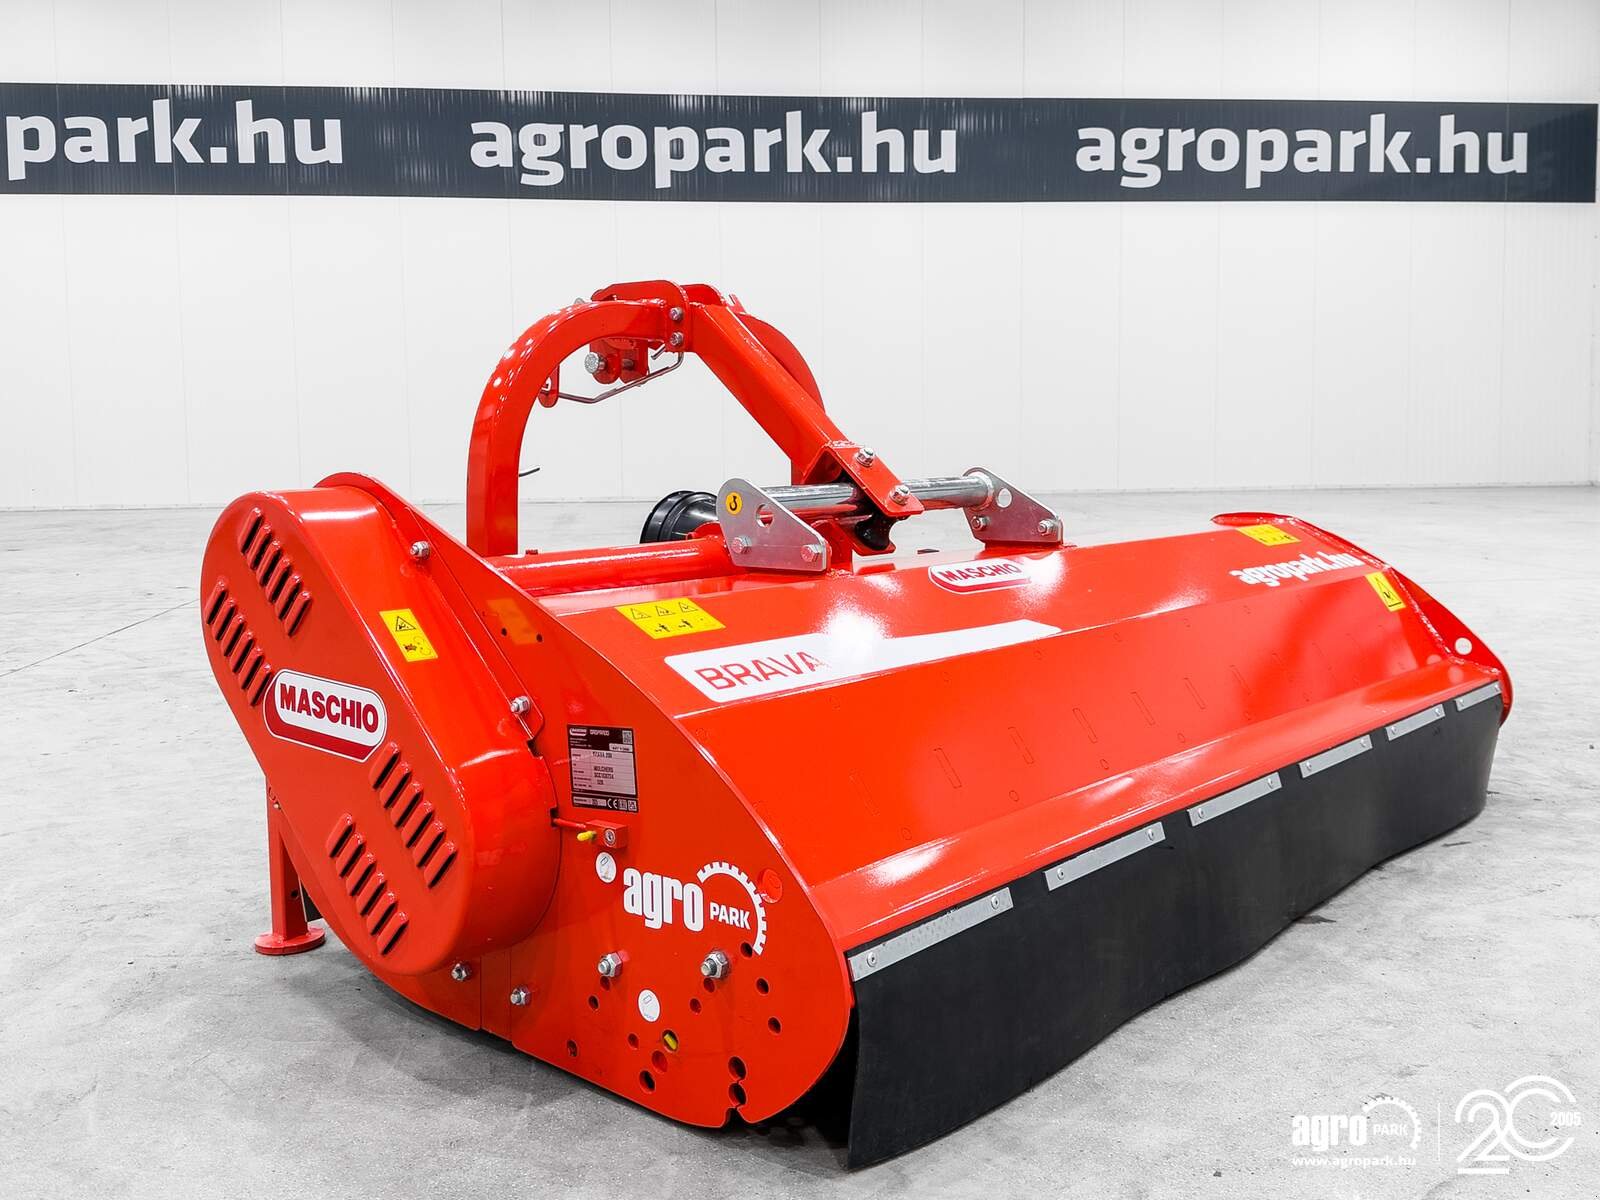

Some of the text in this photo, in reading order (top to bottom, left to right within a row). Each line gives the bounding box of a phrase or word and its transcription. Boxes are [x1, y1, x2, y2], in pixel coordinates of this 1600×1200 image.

[5, 98, 343, 181] park.hu
[470, 109, 957, 189] agropark.hu
[1075, 113, 1529, 190] agropark.hu
[938, 563, 1023, 582] MASCHIO
[1229, 551, 1366, 587] agropark.hu
[280, 682, 379, 734] MASCHIO
[623, 868, 751, 932] agro PARK
